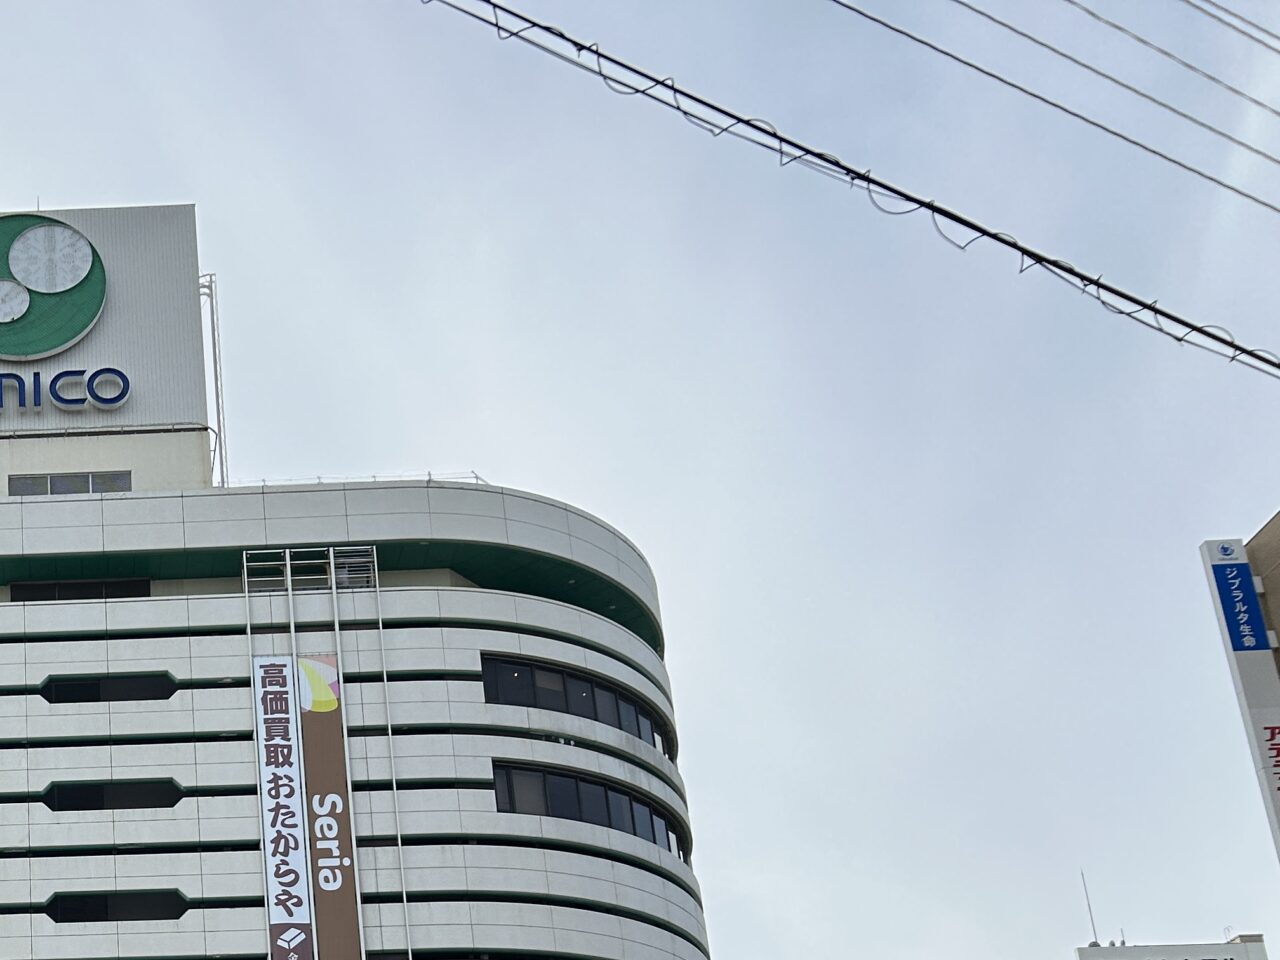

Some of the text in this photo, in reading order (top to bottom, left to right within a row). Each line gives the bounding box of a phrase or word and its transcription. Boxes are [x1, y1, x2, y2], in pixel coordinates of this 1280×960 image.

[1225, 567, 1257, 647] ジブラルタ生命
[312, 793, 351, 891] Seria
